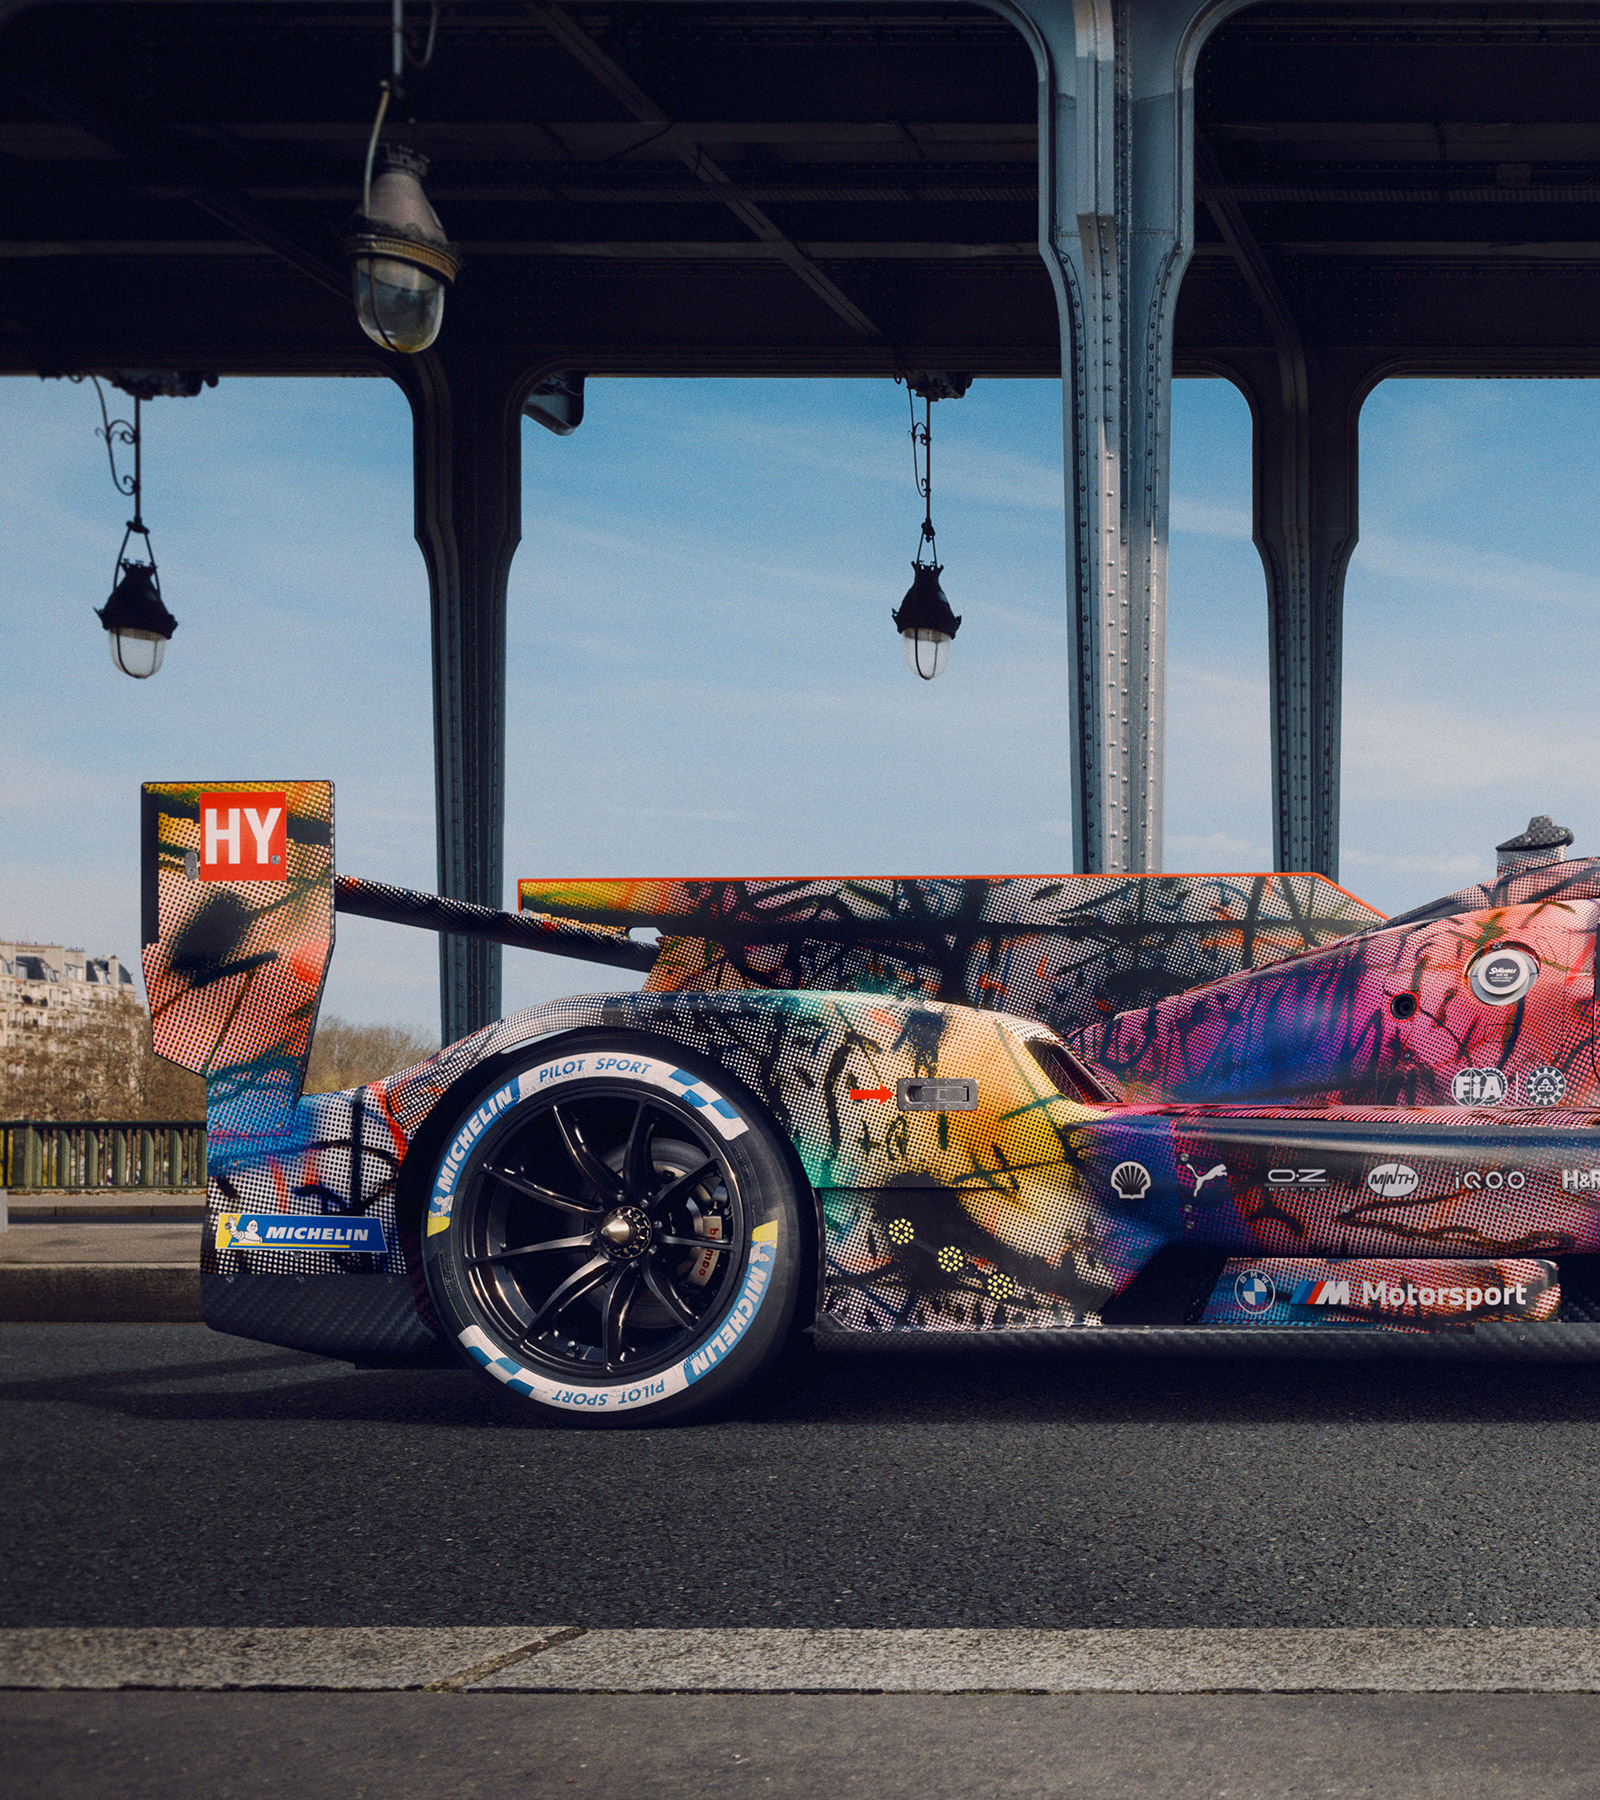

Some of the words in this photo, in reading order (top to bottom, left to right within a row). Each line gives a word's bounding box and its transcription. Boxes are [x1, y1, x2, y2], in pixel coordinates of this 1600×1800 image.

[205, 808, 282, 864] HY
[539, 1060, 586, 1082] PILOT
[595, 1058, 652, 1075] SPORT
[437, 1084, 514, 1194] MICHELIN
[265, 1226, 369, 1241] MICHELIN
[1240, 1271, 1269, 1284] BMW
[1362, 1280, 1528, 1311] Motorsport
[690, 1264, 767, 1376] MICHELIN
[552, 1388, 608, 1406] SPORT
[618, 1379, 665, 1404] PILOT
